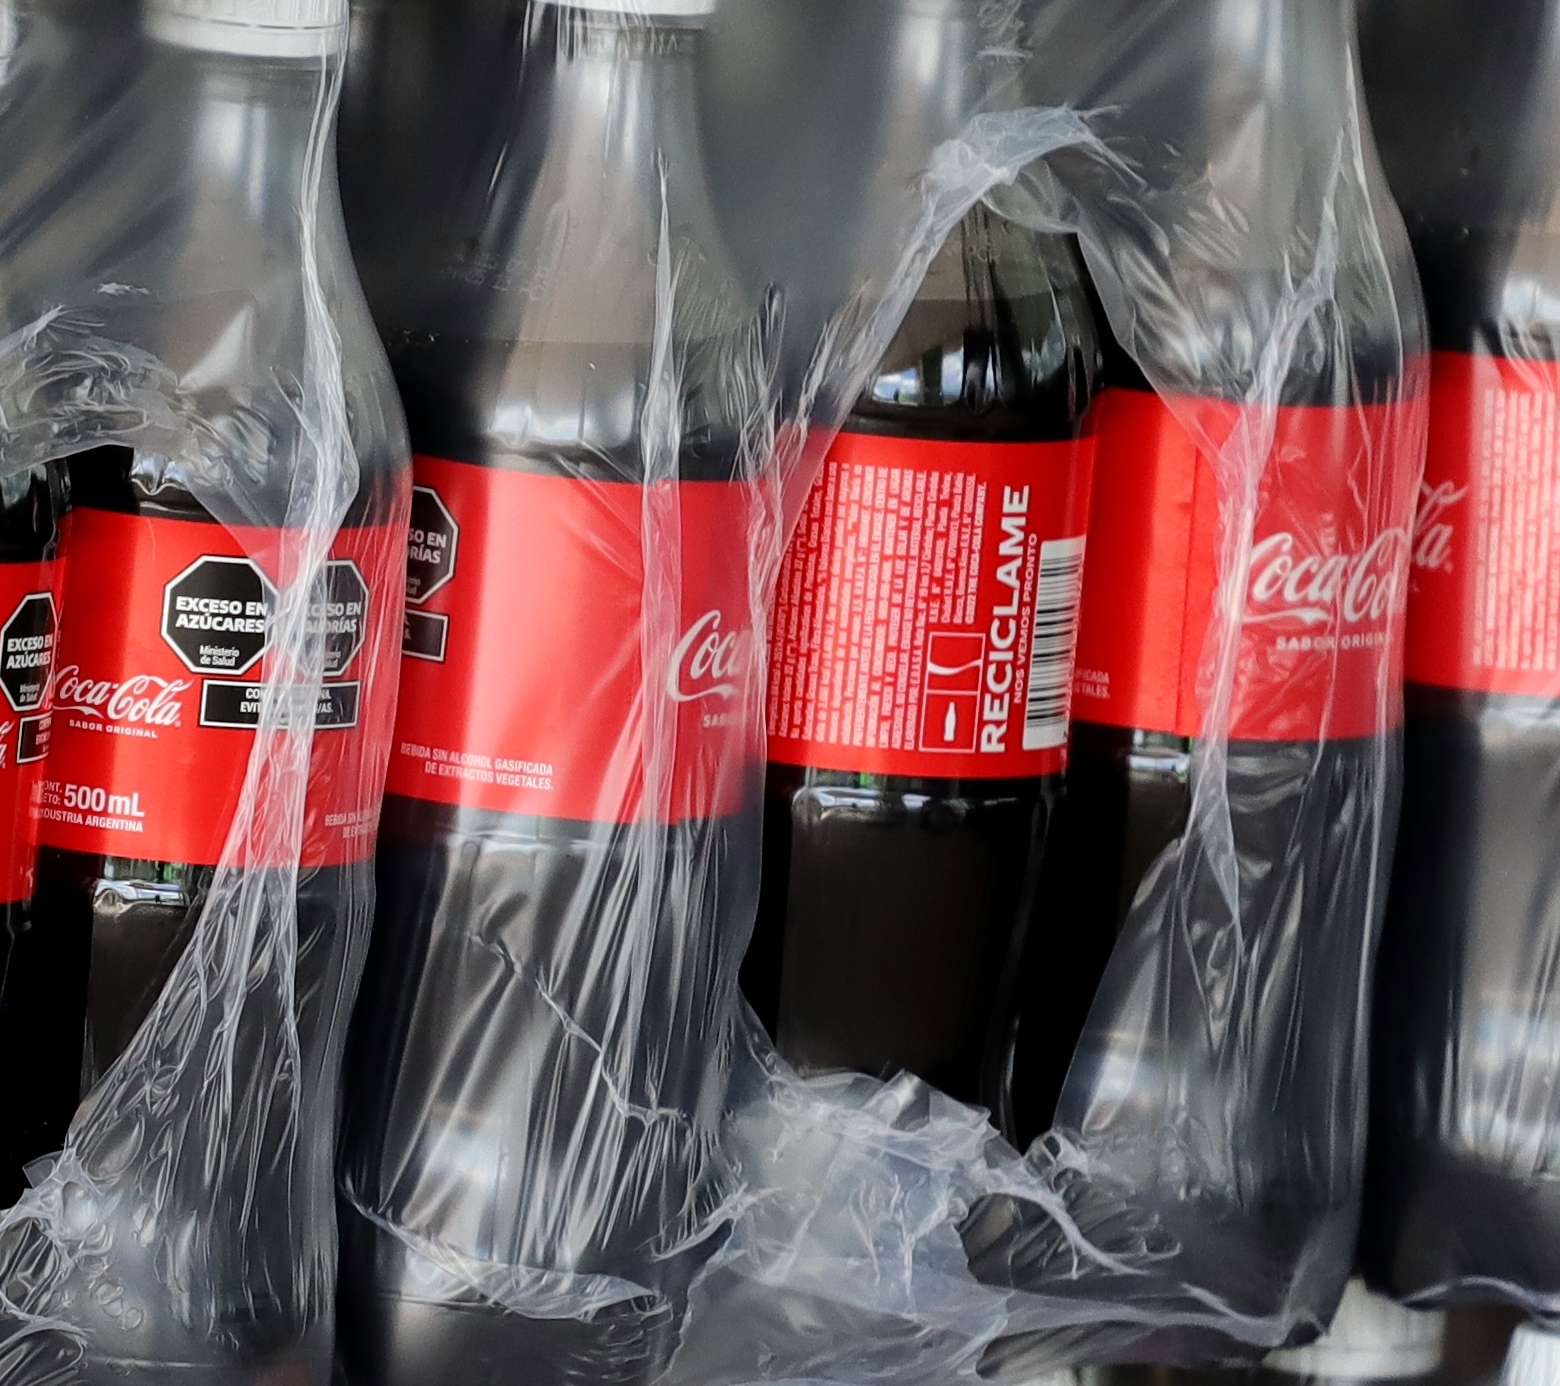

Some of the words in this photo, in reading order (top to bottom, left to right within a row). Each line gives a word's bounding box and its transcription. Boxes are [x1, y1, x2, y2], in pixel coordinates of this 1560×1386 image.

[427, 532, 447, 548] EN
[1021, 533, 1037, 603] PRONTO
[176, 596, 239, 614] EXCESO
[246, 600, 268, 616] EN
[175, 612, 266, 633] AZÚCARES
[980, 485, 1030, 753] RECICLAME
[7, 634, 43, 652] EXCESO
[1015, 606, 1031, 665] VEMOS
[6, 650, 51, 669] AZÚCARES
[199, 644, 240, 658] Ministerio
[212, 655, 236, 667] Salud
[52, 664, 193, 727] Coca-Cola
[1012, 666, 1025, 704] NOS
[69, 720, 103, 732] SABOR
[105, 724, 158, 739] ORIGINAL
[401, 742, 431, 758] BEBIDA
[432, 747, 448, 760] SIN
[449, 750, 492, 769] ALCOHOL
[494, 757, 553, 776] GASIFICADA
[425, 761, 437, 774] DE
[438, 763, 494, 783] EXTRACTOS
[496, 771, 554, 790] VEGETALES.
[64, 784, 145, 817] 500mL
[85, 813, 144, 832] ARGENTINA
